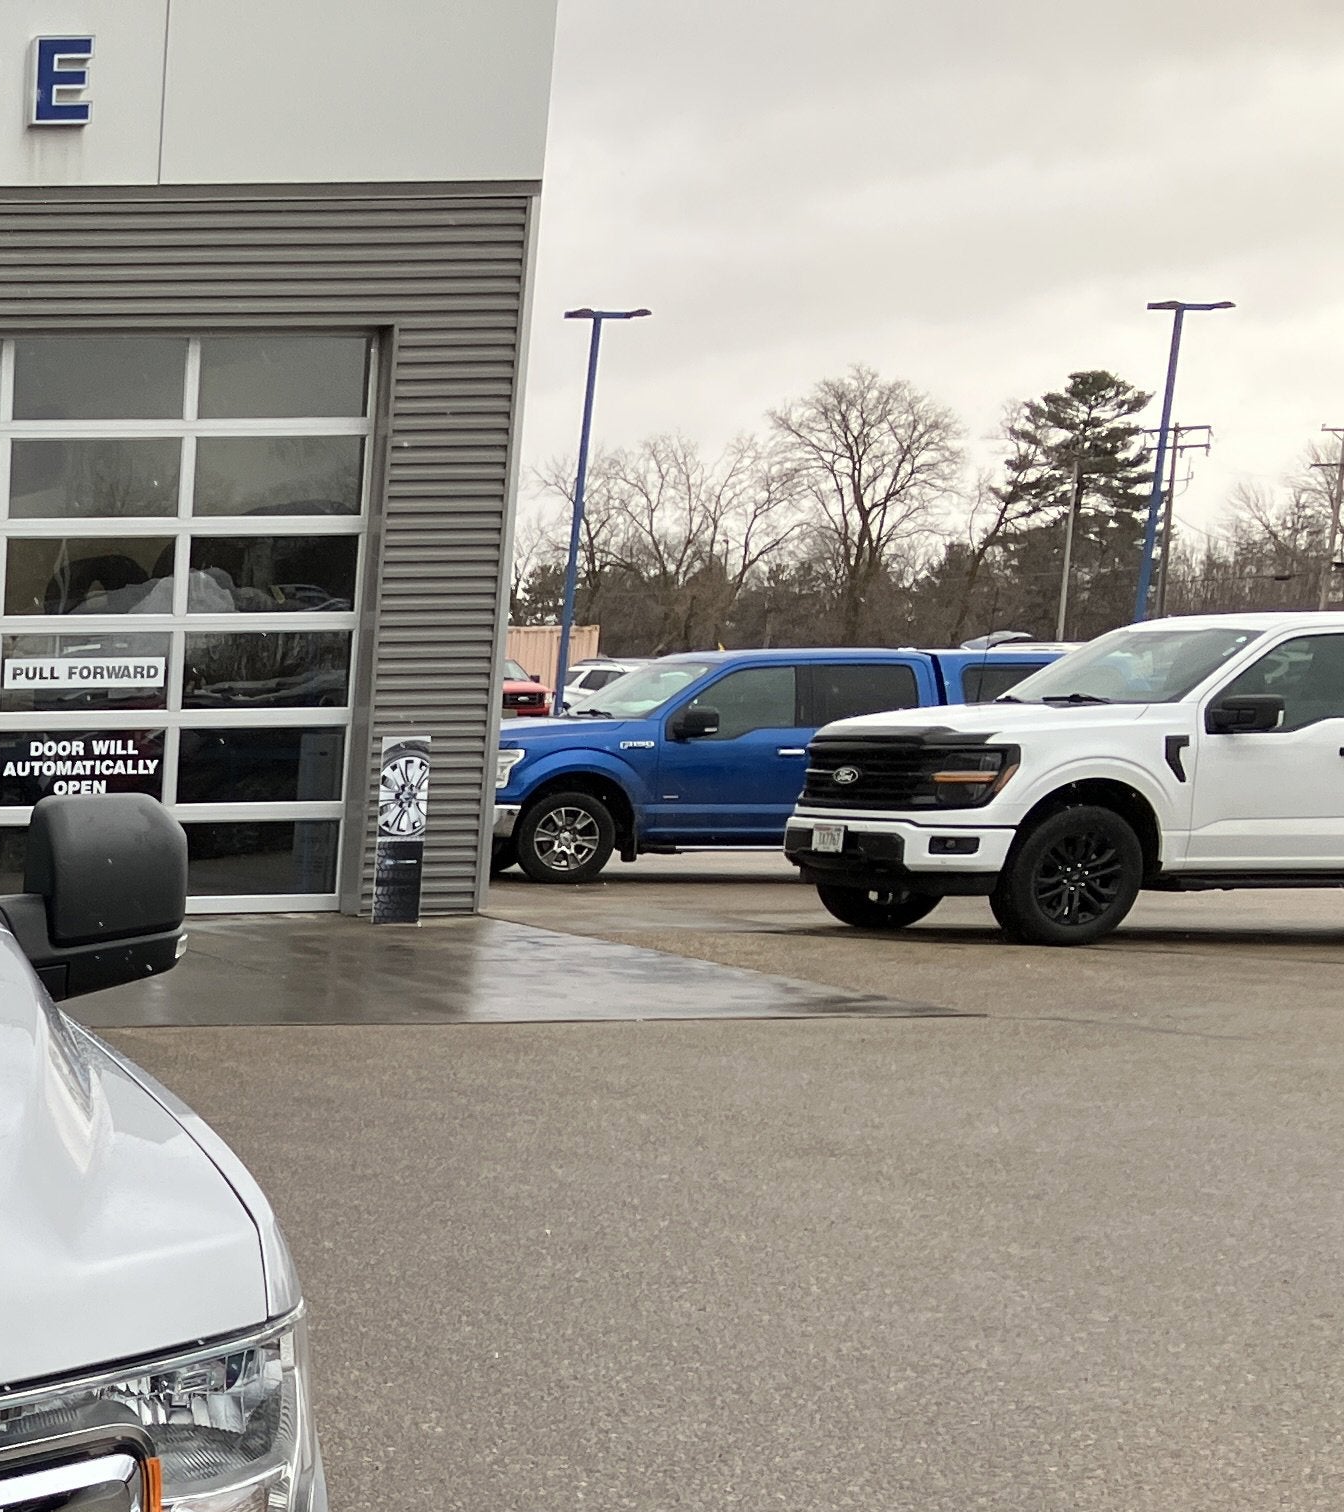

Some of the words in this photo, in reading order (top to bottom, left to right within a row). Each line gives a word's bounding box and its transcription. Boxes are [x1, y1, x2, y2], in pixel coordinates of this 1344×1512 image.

[12, 666, 60, 681] PULL
[67, 665, 159, 681] FORWARD
[30, 741, 85, 757] DOOR
[92, 740, 139, 755] WILL
[3, 759, 159, 777] AUTOMATICALLY
[53, 780, 107, 796] OPEN
